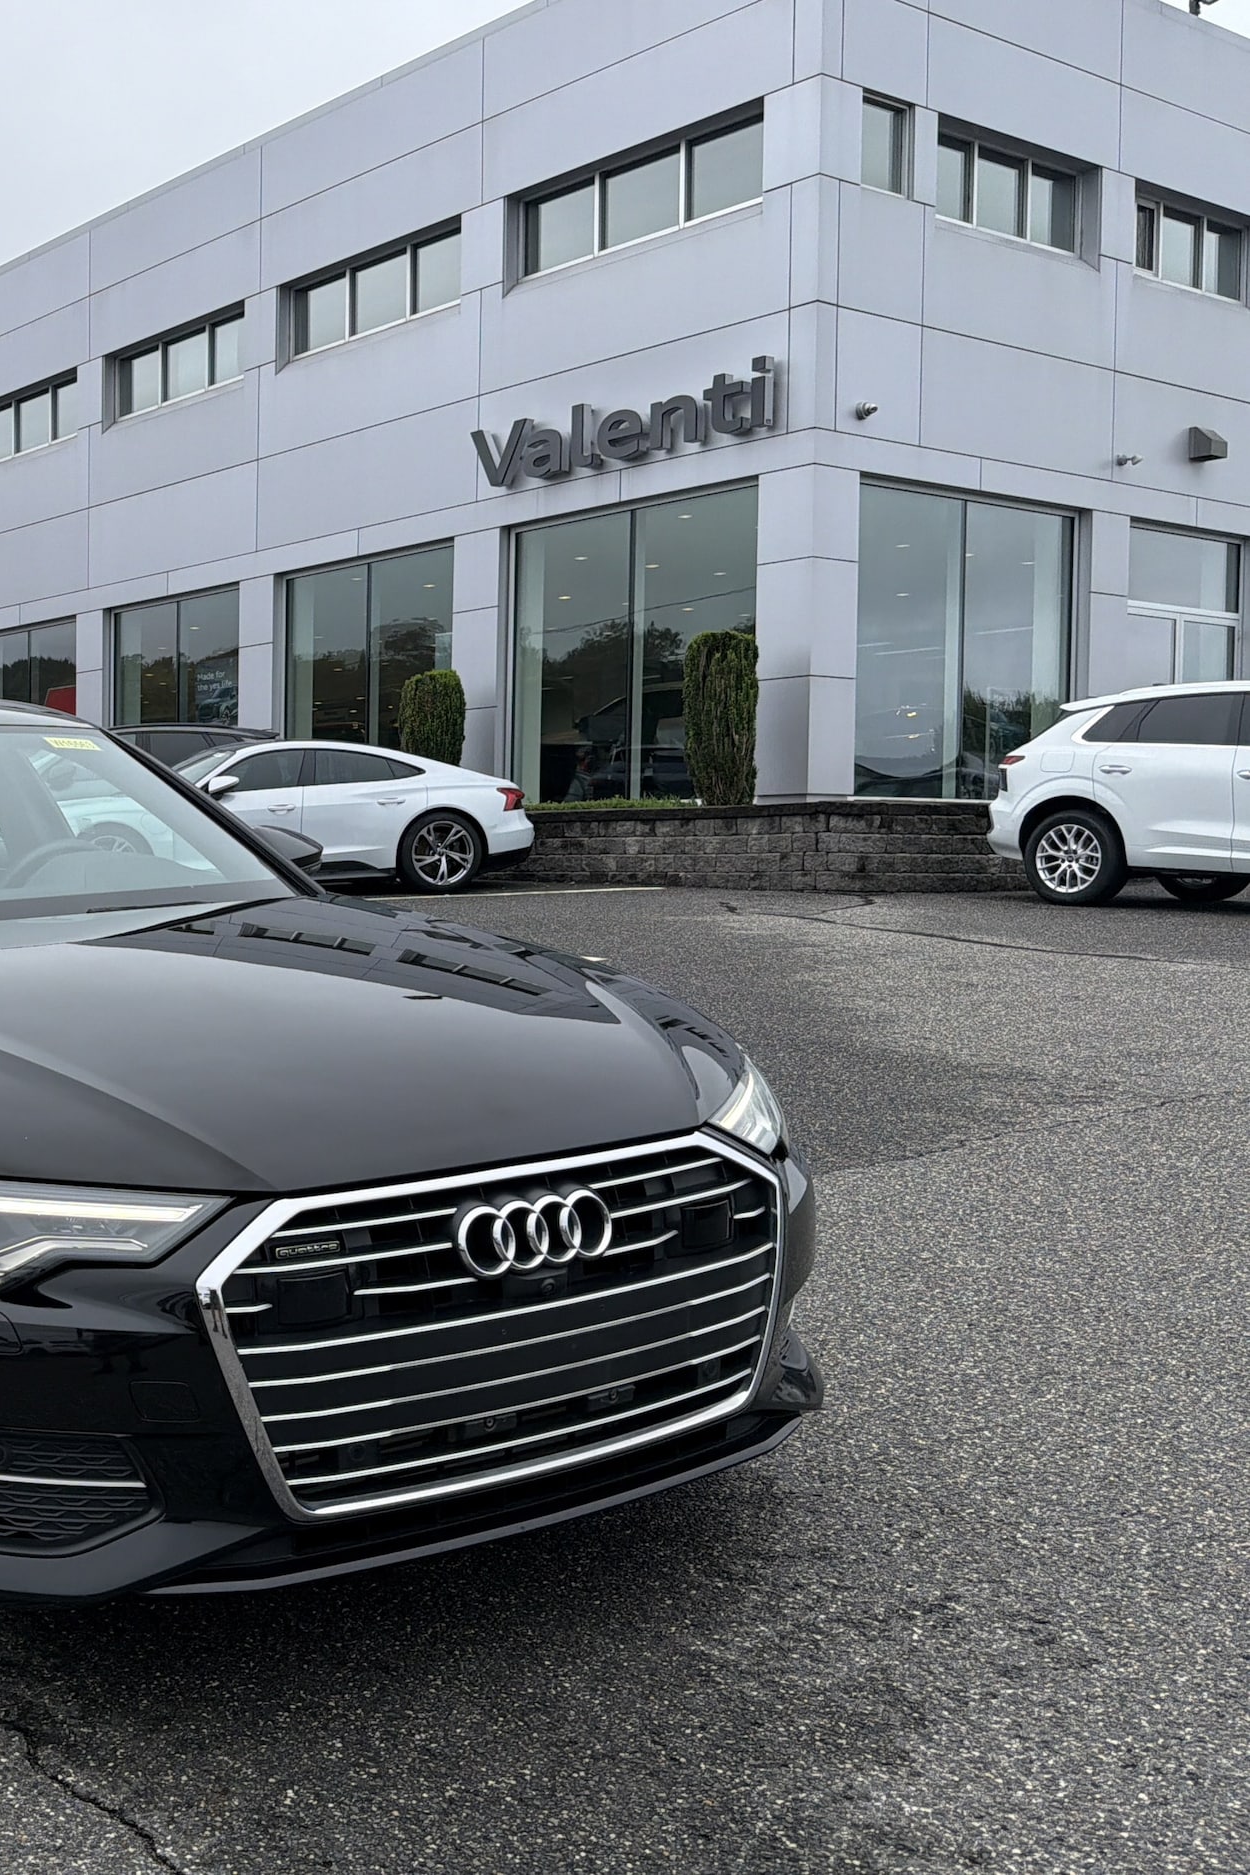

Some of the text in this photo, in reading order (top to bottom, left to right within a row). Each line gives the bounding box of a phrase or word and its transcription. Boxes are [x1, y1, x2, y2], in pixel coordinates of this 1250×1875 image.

[471, 355, 775, 488] Valenti
[197, 670, 225, 681] Made for
[197, 683, 209, 691] the
[279, 1243, 337, 1257] quattro
